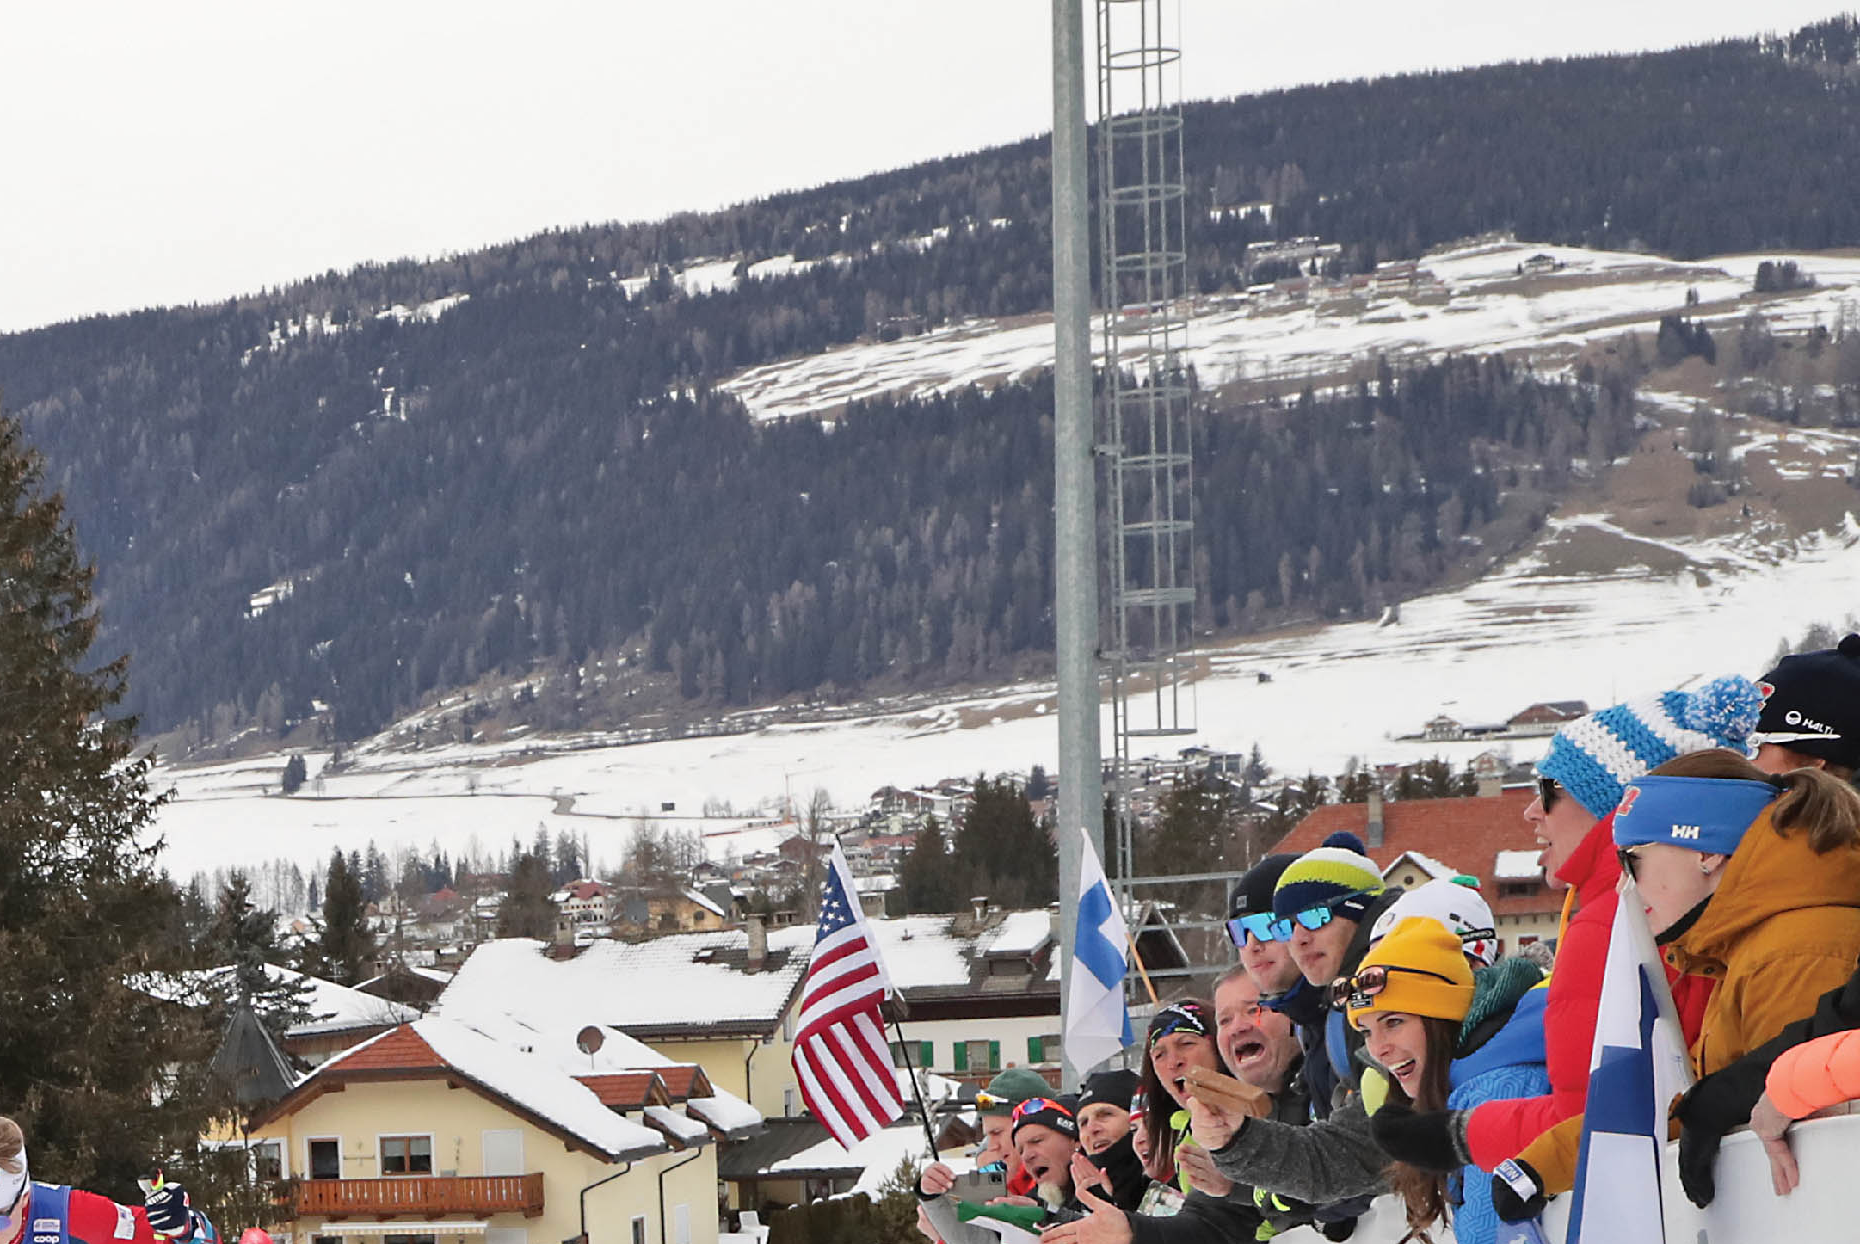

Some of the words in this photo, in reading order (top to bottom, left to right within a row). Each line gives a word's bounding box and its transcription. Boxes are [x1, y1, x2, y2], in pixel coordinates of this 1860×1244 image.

[1802, 718, 1836, 735] HALTI
[1670, 824, 1700, 840] HH
[33, 1235, 60, 1244] coop
